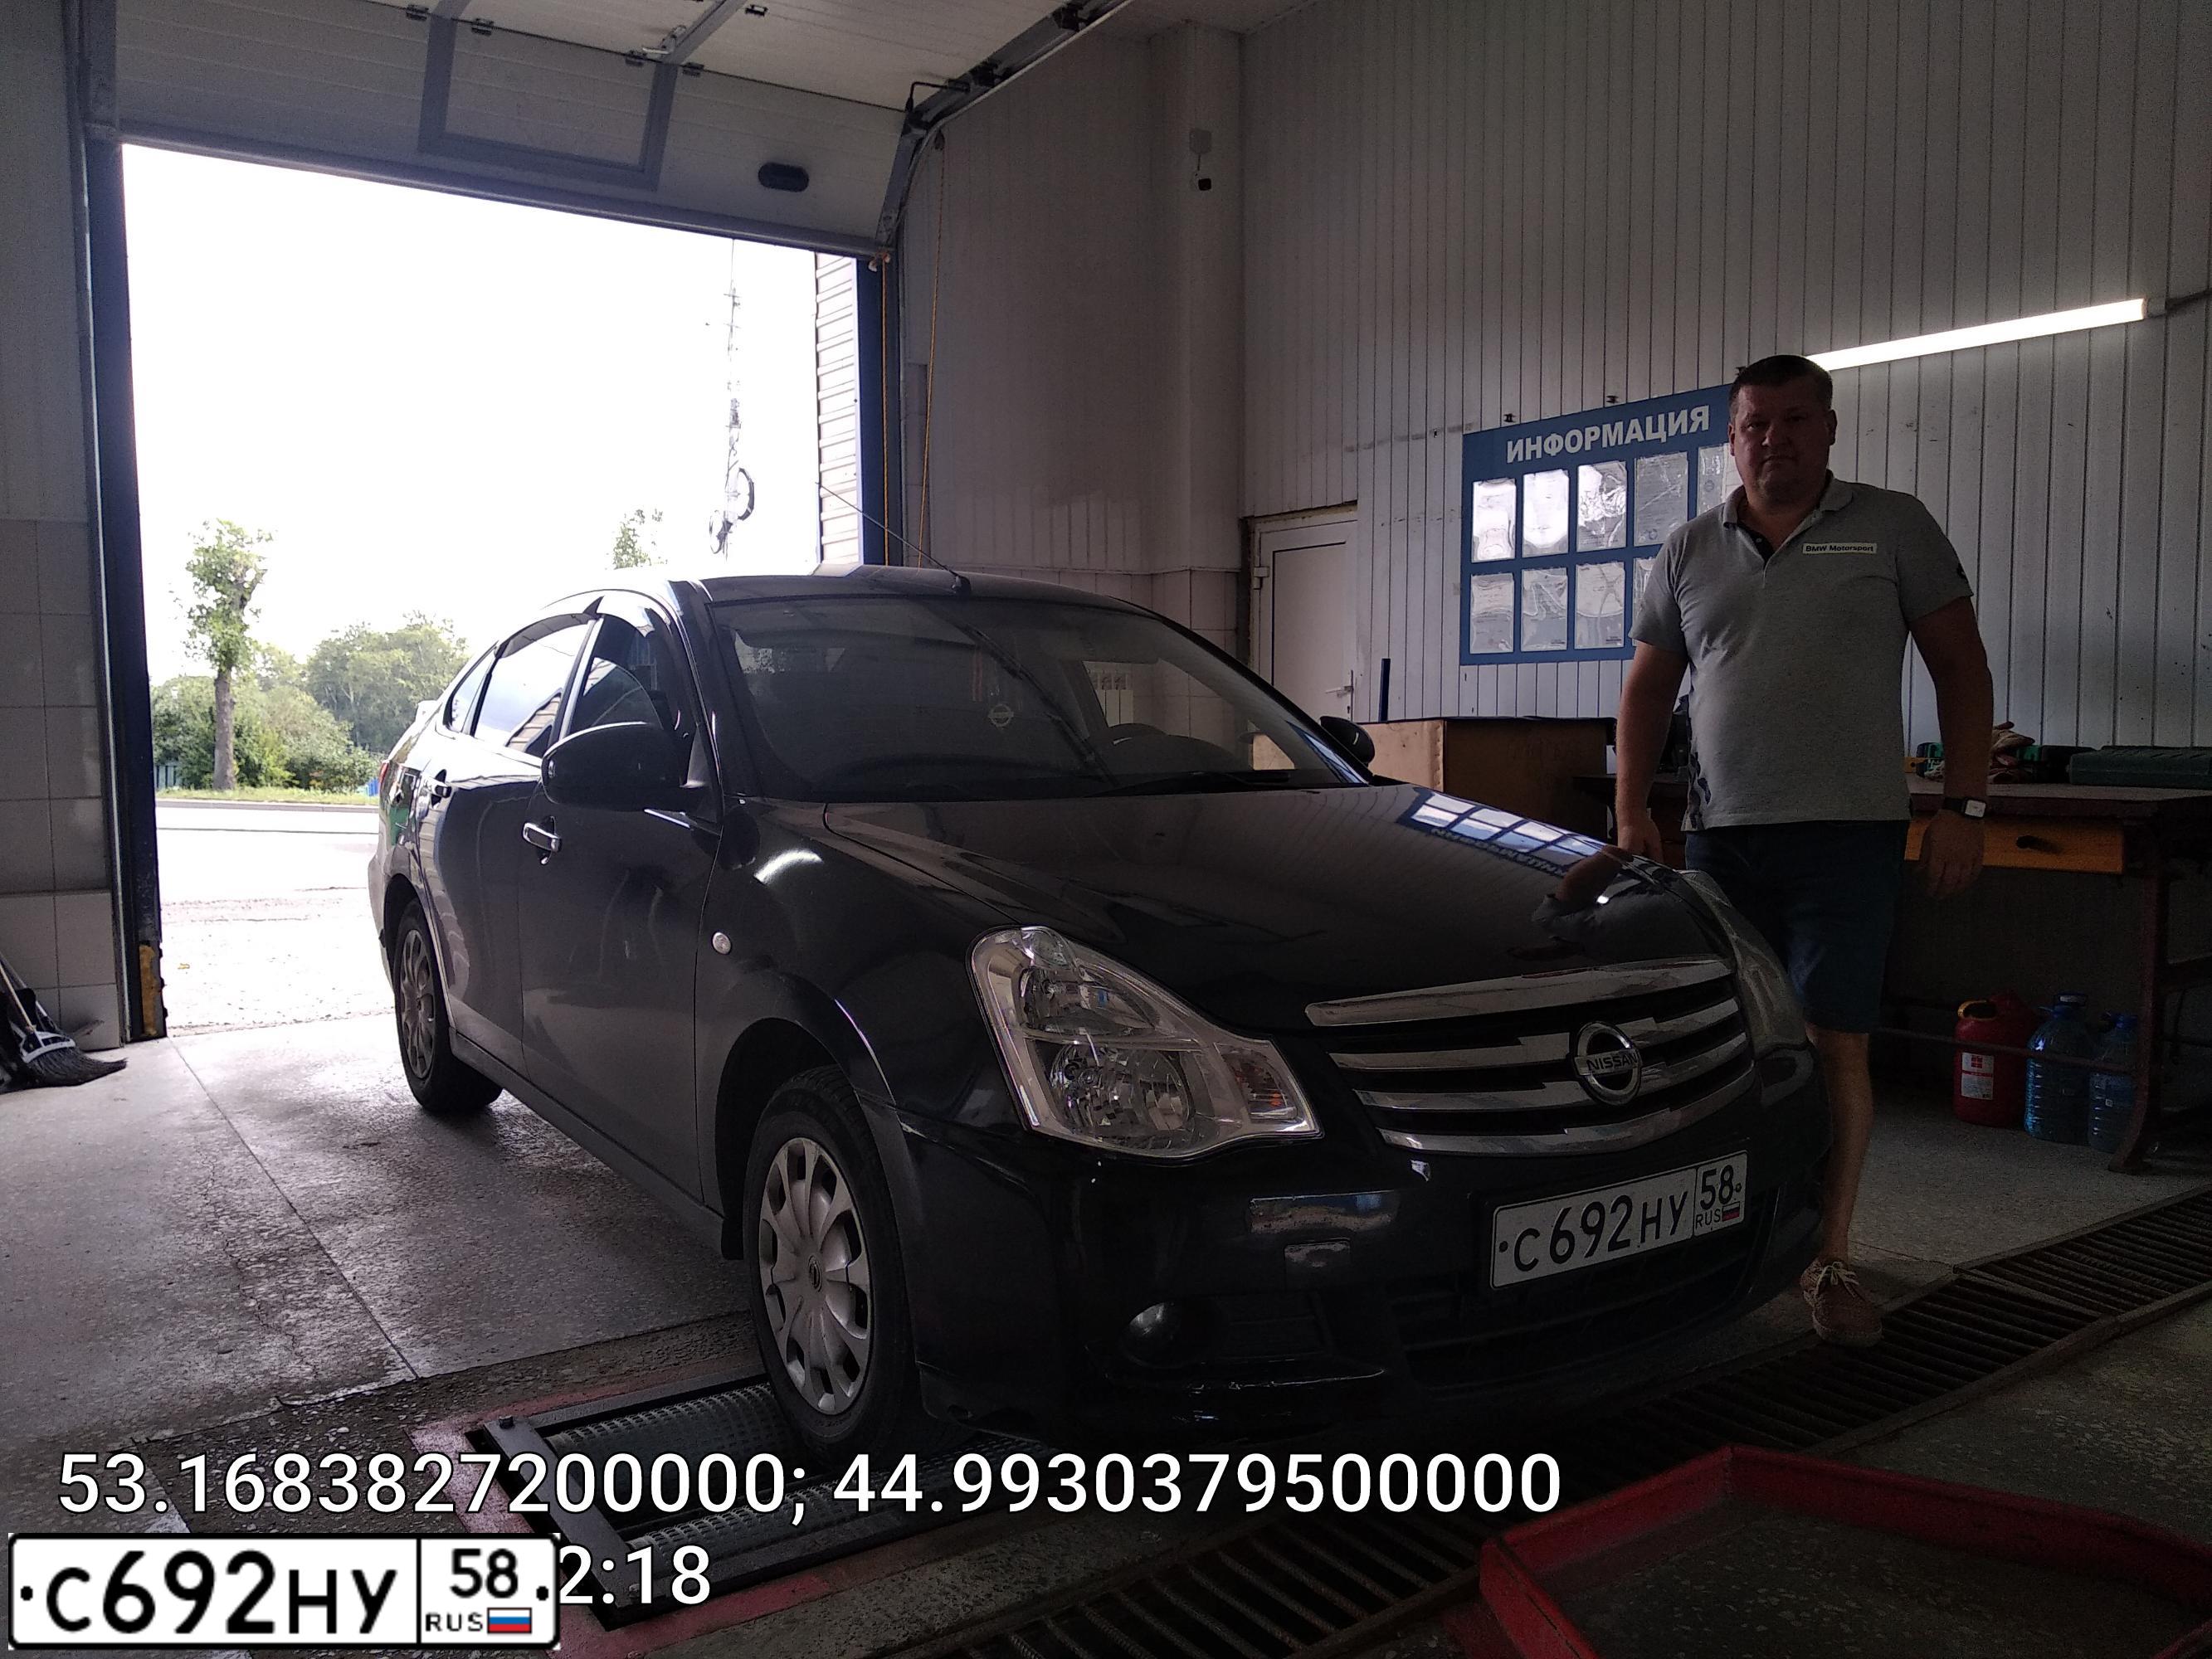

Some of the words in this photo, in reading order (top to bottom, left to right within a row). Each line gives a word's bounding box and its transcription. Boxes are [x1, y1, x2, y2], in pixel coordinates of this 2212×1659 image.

[1506, 404, 1710, 464] ИНФОРМАЦИЯ
[1586, 1054, 1638, 1071] NISSAN
[1699, 1165, 1734, 1210] 58
[1695, 1209, 1721, 1230] RUS
